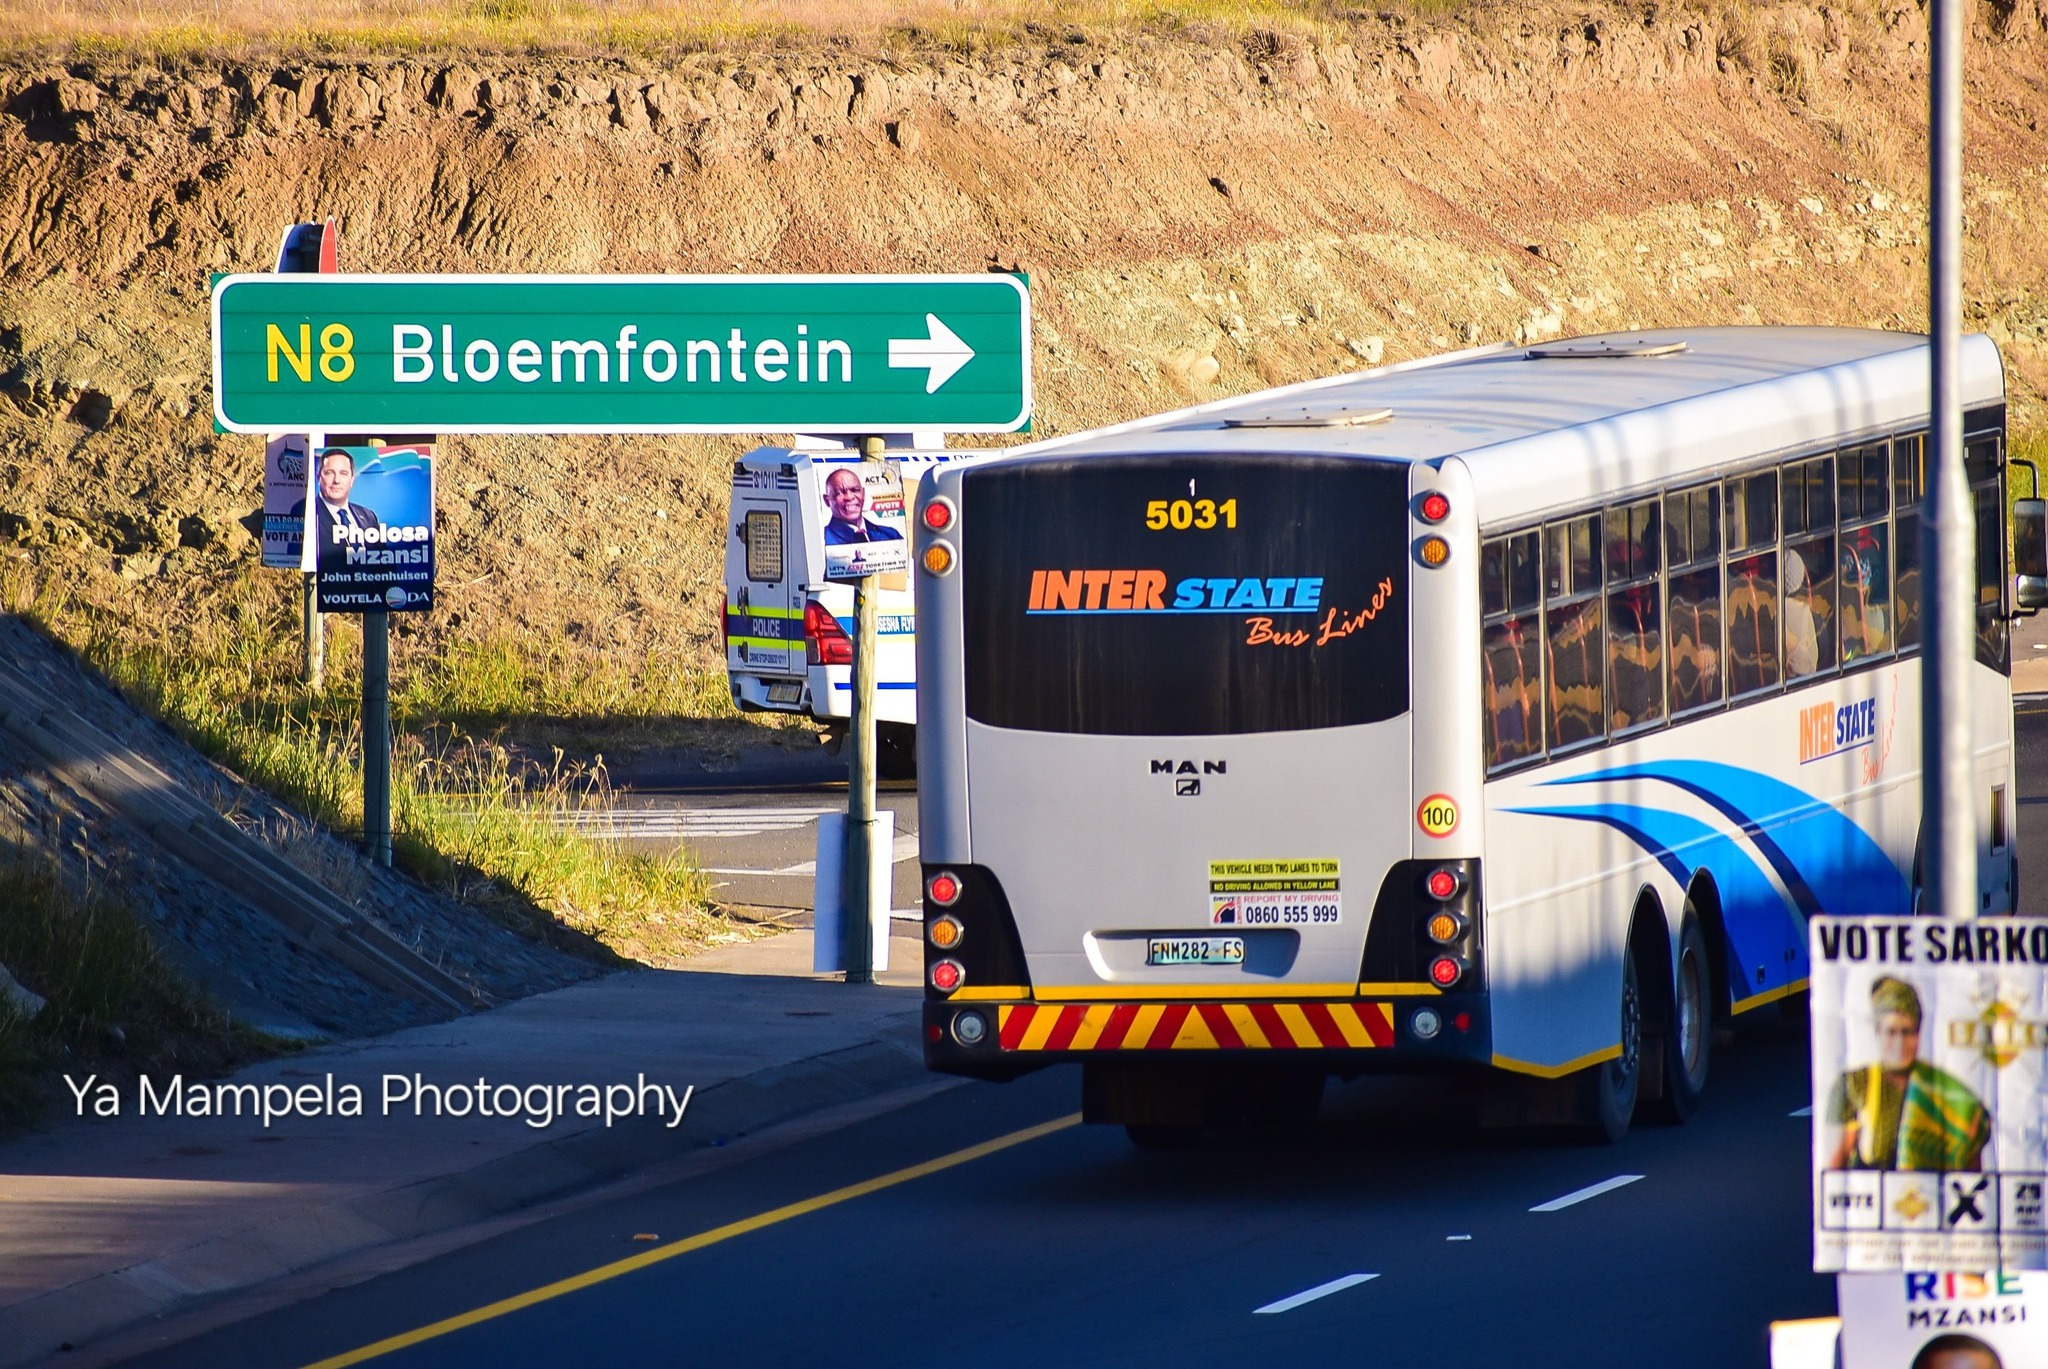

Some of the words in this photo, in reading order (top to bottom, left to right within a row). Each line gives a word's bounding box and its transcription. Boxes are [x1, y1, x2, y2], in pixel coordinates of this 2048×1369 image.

[266, 323, 356, 383] N8
[391, 323, 854, 383] Bloemfontein
[287, 472, 305, 481] ANC
[1145, 498, 1238, 531] 5031
[264, 530, 290, 542] VOTE
[332, 522, 429, 544] Pholosa
[345, 544, 429, 565] Mzansi
[320, 572, 352, 583] John
[322, 593, 383, 604] VOUTELA
[407, 591, 430, 603] DA
[1027, 569, 1168, 610] INTER
[1173, 577, 1325, 609] STATE
[753, 618, 781, 638] POLICE
[1245, 616, 1311, 647] Bus
[1799, 700, 1836, 764] INTER
[1836, 697, 1876, 746] STATE
[1150, 759, 1228, 775] MAN
[1423, 806, 1455, 827] 100
[1210, 864, 1226, 875] THIS
[1227, 863, 1252, 874] VEHICLE
[1253, 863, 1274, 874] NEEDS
[1275, 863, 1289, 873] TWO
[1290, 862, 1310, 873] LANES
[1311, 862, 1320, 872] TO
[1321, 862, 1339, 872] TURN
[1213, 882, 1224, 892] NO
[1225, 882, 1252, 891] DRIVING
[1253, 881, 1283, 891] ALLOWED
[1283, 881, 1291, 890] IN
[1292, 881, 1318, 890] YELLOW
[1319, 880, 1336, 890] LANE
[1243, 894, 1281, 903] REPORT
[1284, 894, 1299, 903] MY
[1300, 894, 1339, 903] DRIVING
[1245, 905, 1280, 924] 0860
[1283, 904, 1309, 923] 555
[1312, 904, 1338, 922] 999
[1151, 942, 1210, 963] FNM282
[1223, 941, 1243, 959] FS
[1819, 924, 1914, 963] VOTE
[1905, 1269, 2024, 1302] RISE
[1908, 1304, 2028, 1329] MZANSI
